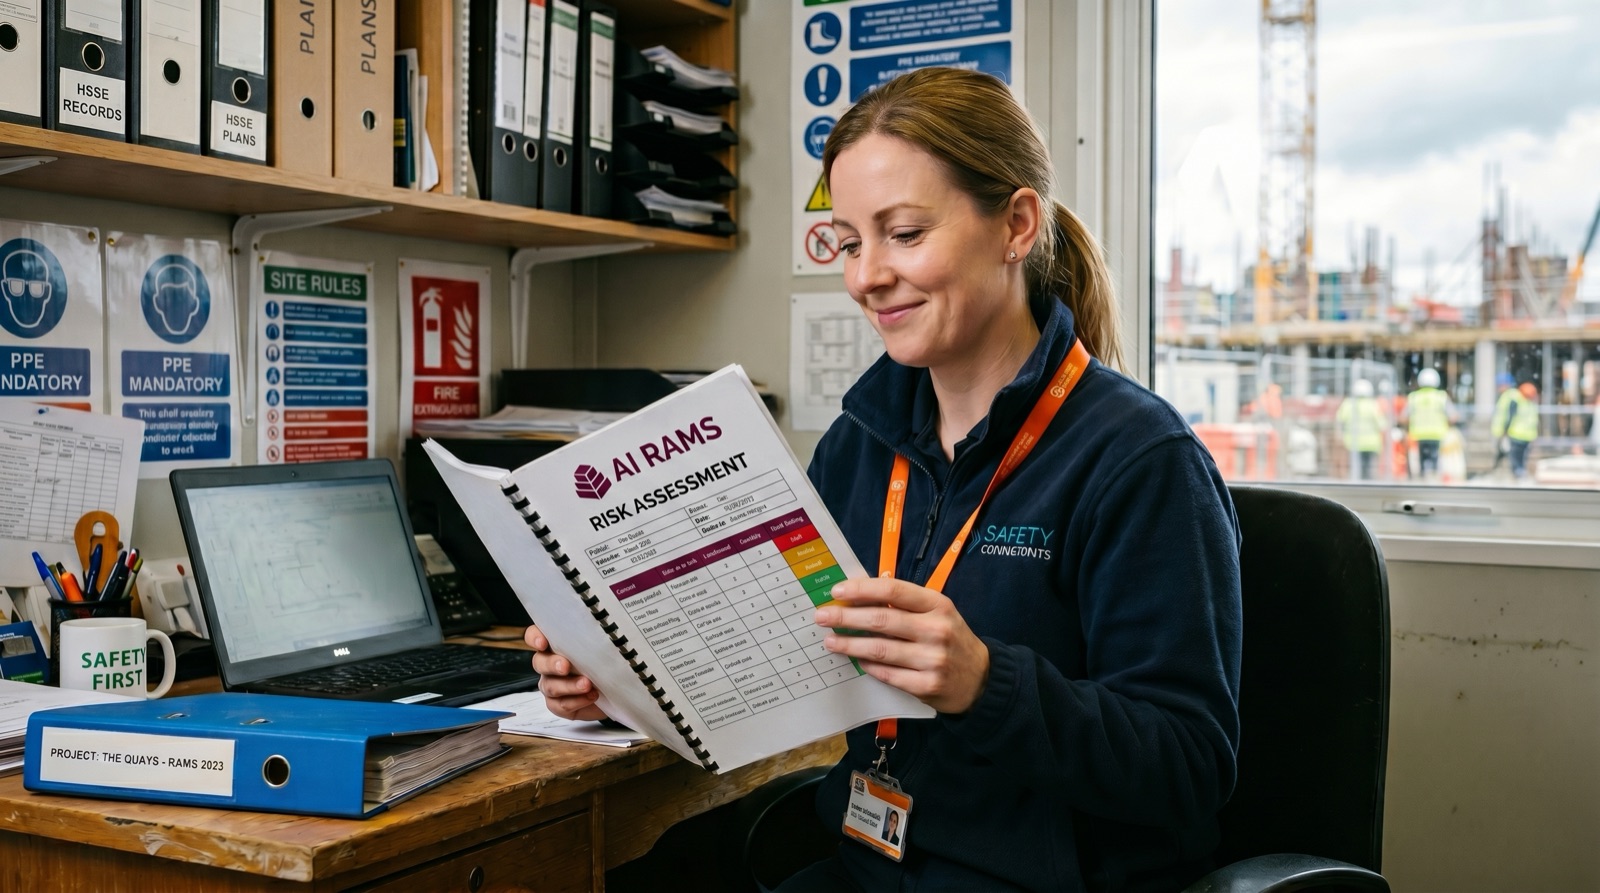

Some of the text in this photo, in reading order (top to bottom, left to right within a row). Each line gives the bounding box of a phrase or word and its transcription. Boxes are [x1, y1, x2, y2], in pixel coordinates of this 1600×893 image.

[361, 0, 376, 74] PLANS
[77, 83, 109, 100] HSSE
[63, 99, 122, 121] RECORDS
[226, 114, 253, 129] HSSE
[223, 130, 256, 146] PLANS
[271, 272, 361, 296] SITE RULES
[11, 352, 44, 369] PPE
[163, 357, 192, 373] PPE
[129, 377, 223, 392] MANDATORY
[434, 386, 460, 400] FIRE
[612, 416, 722, 482] AI RAMS
[588, 503, 633, 532] RISK
[633, 452, 748, 514] ASSESSMENT
[984, 525, 1055, 546] SAFETY
[81, 647, 146, 669] SAFETY
[93, 669, 142, 690] FIRST
[50, 748, 99, 761] PROJECT:
[102, 752, 122, 763] THE
[124, 754, 159, 766] QUAYS
[168, 758, 198, 769] RAMS
[201, 760, 224, 771] 2023
